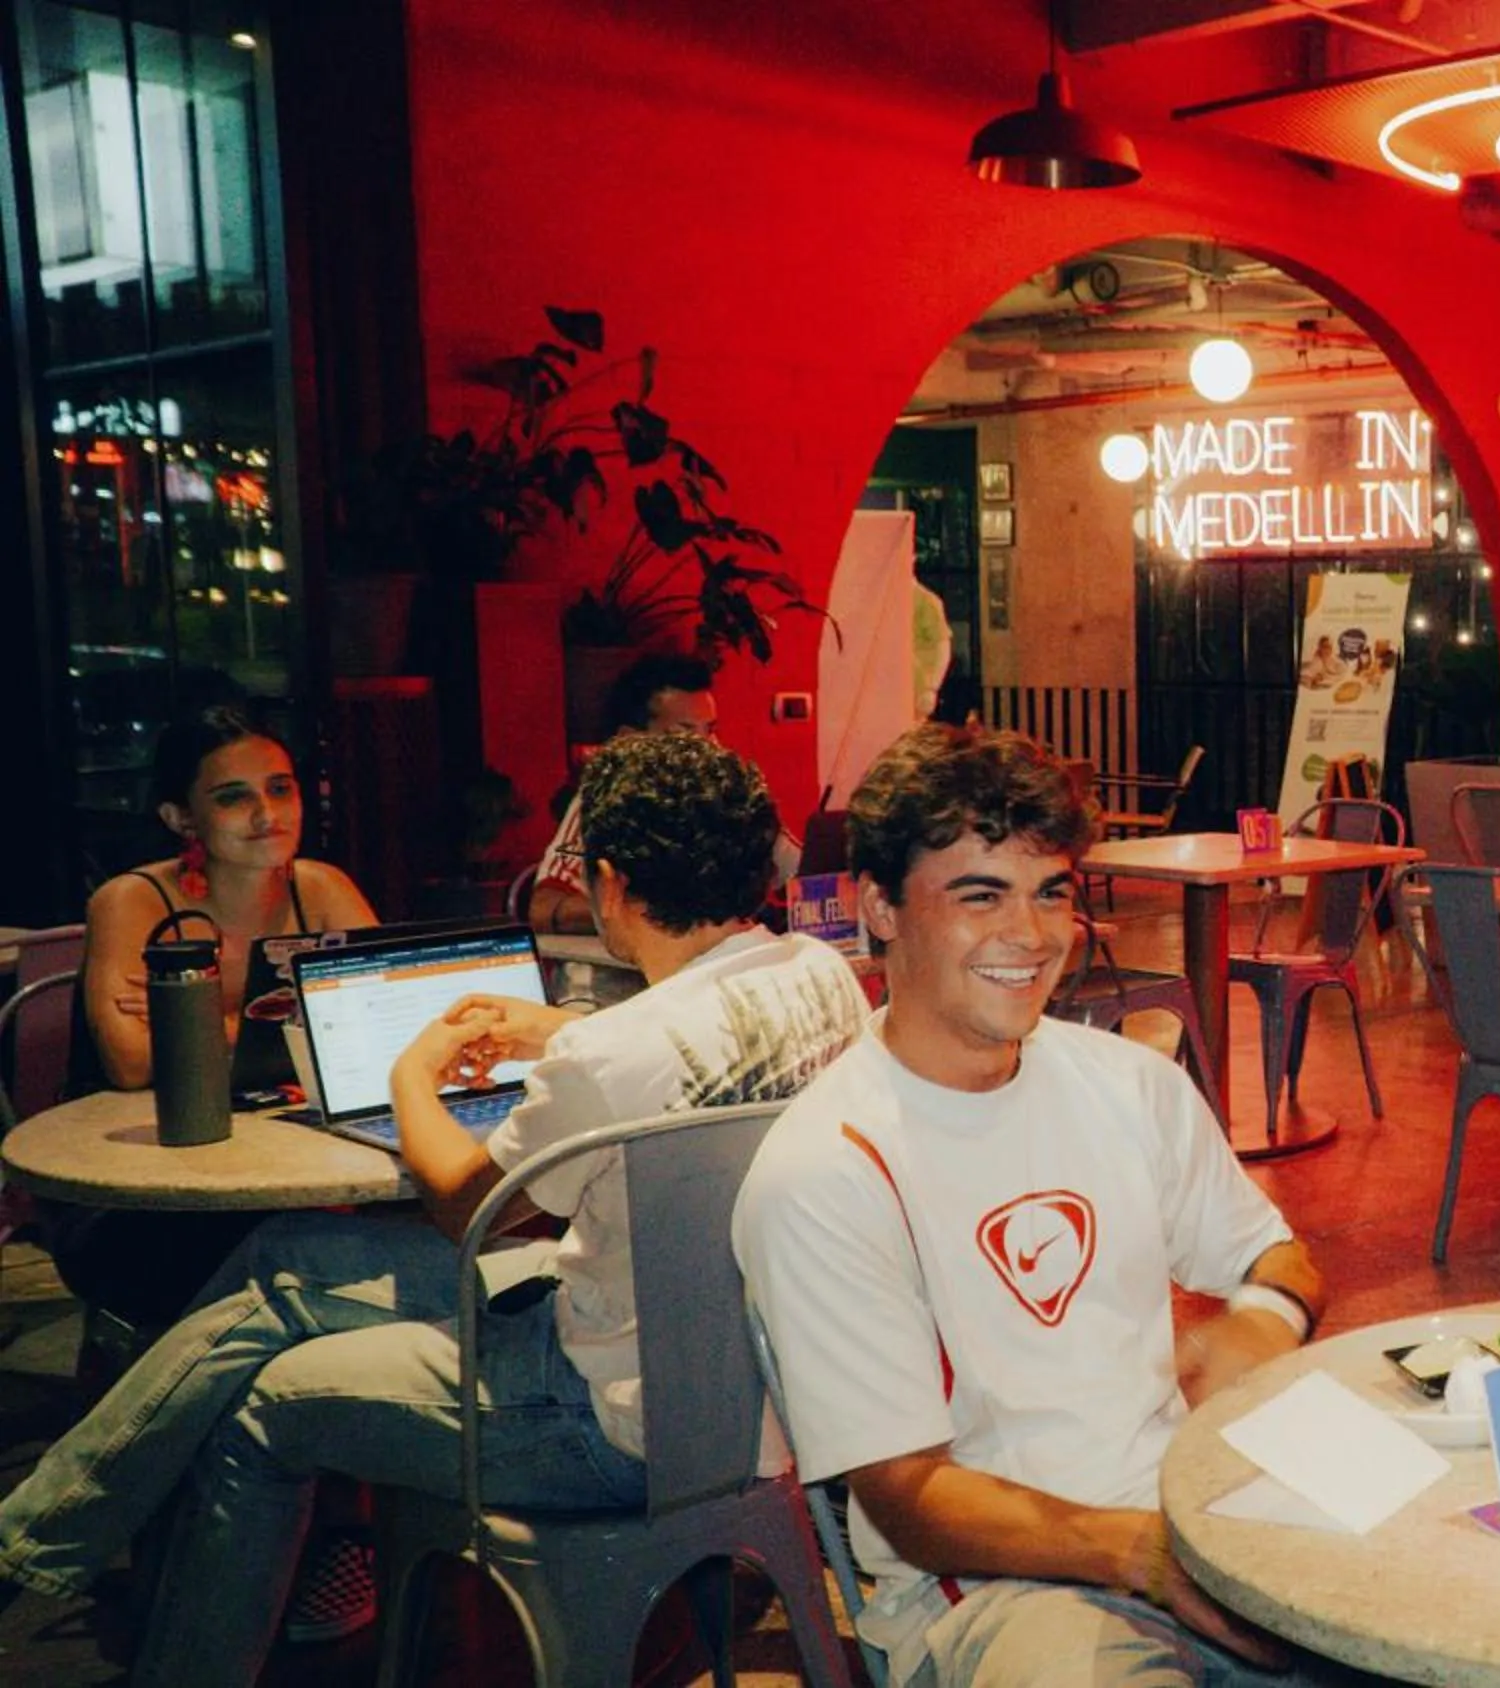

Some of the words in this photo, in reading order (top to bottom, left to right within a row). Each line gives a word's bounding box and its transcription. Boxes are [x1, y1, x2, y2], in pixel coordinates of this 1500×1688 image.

[1153, 417, 1294, 480] MADE
[1356, 410, 1420, 472] IN
[1153, 479, 1422, 549] MEDELLIN
